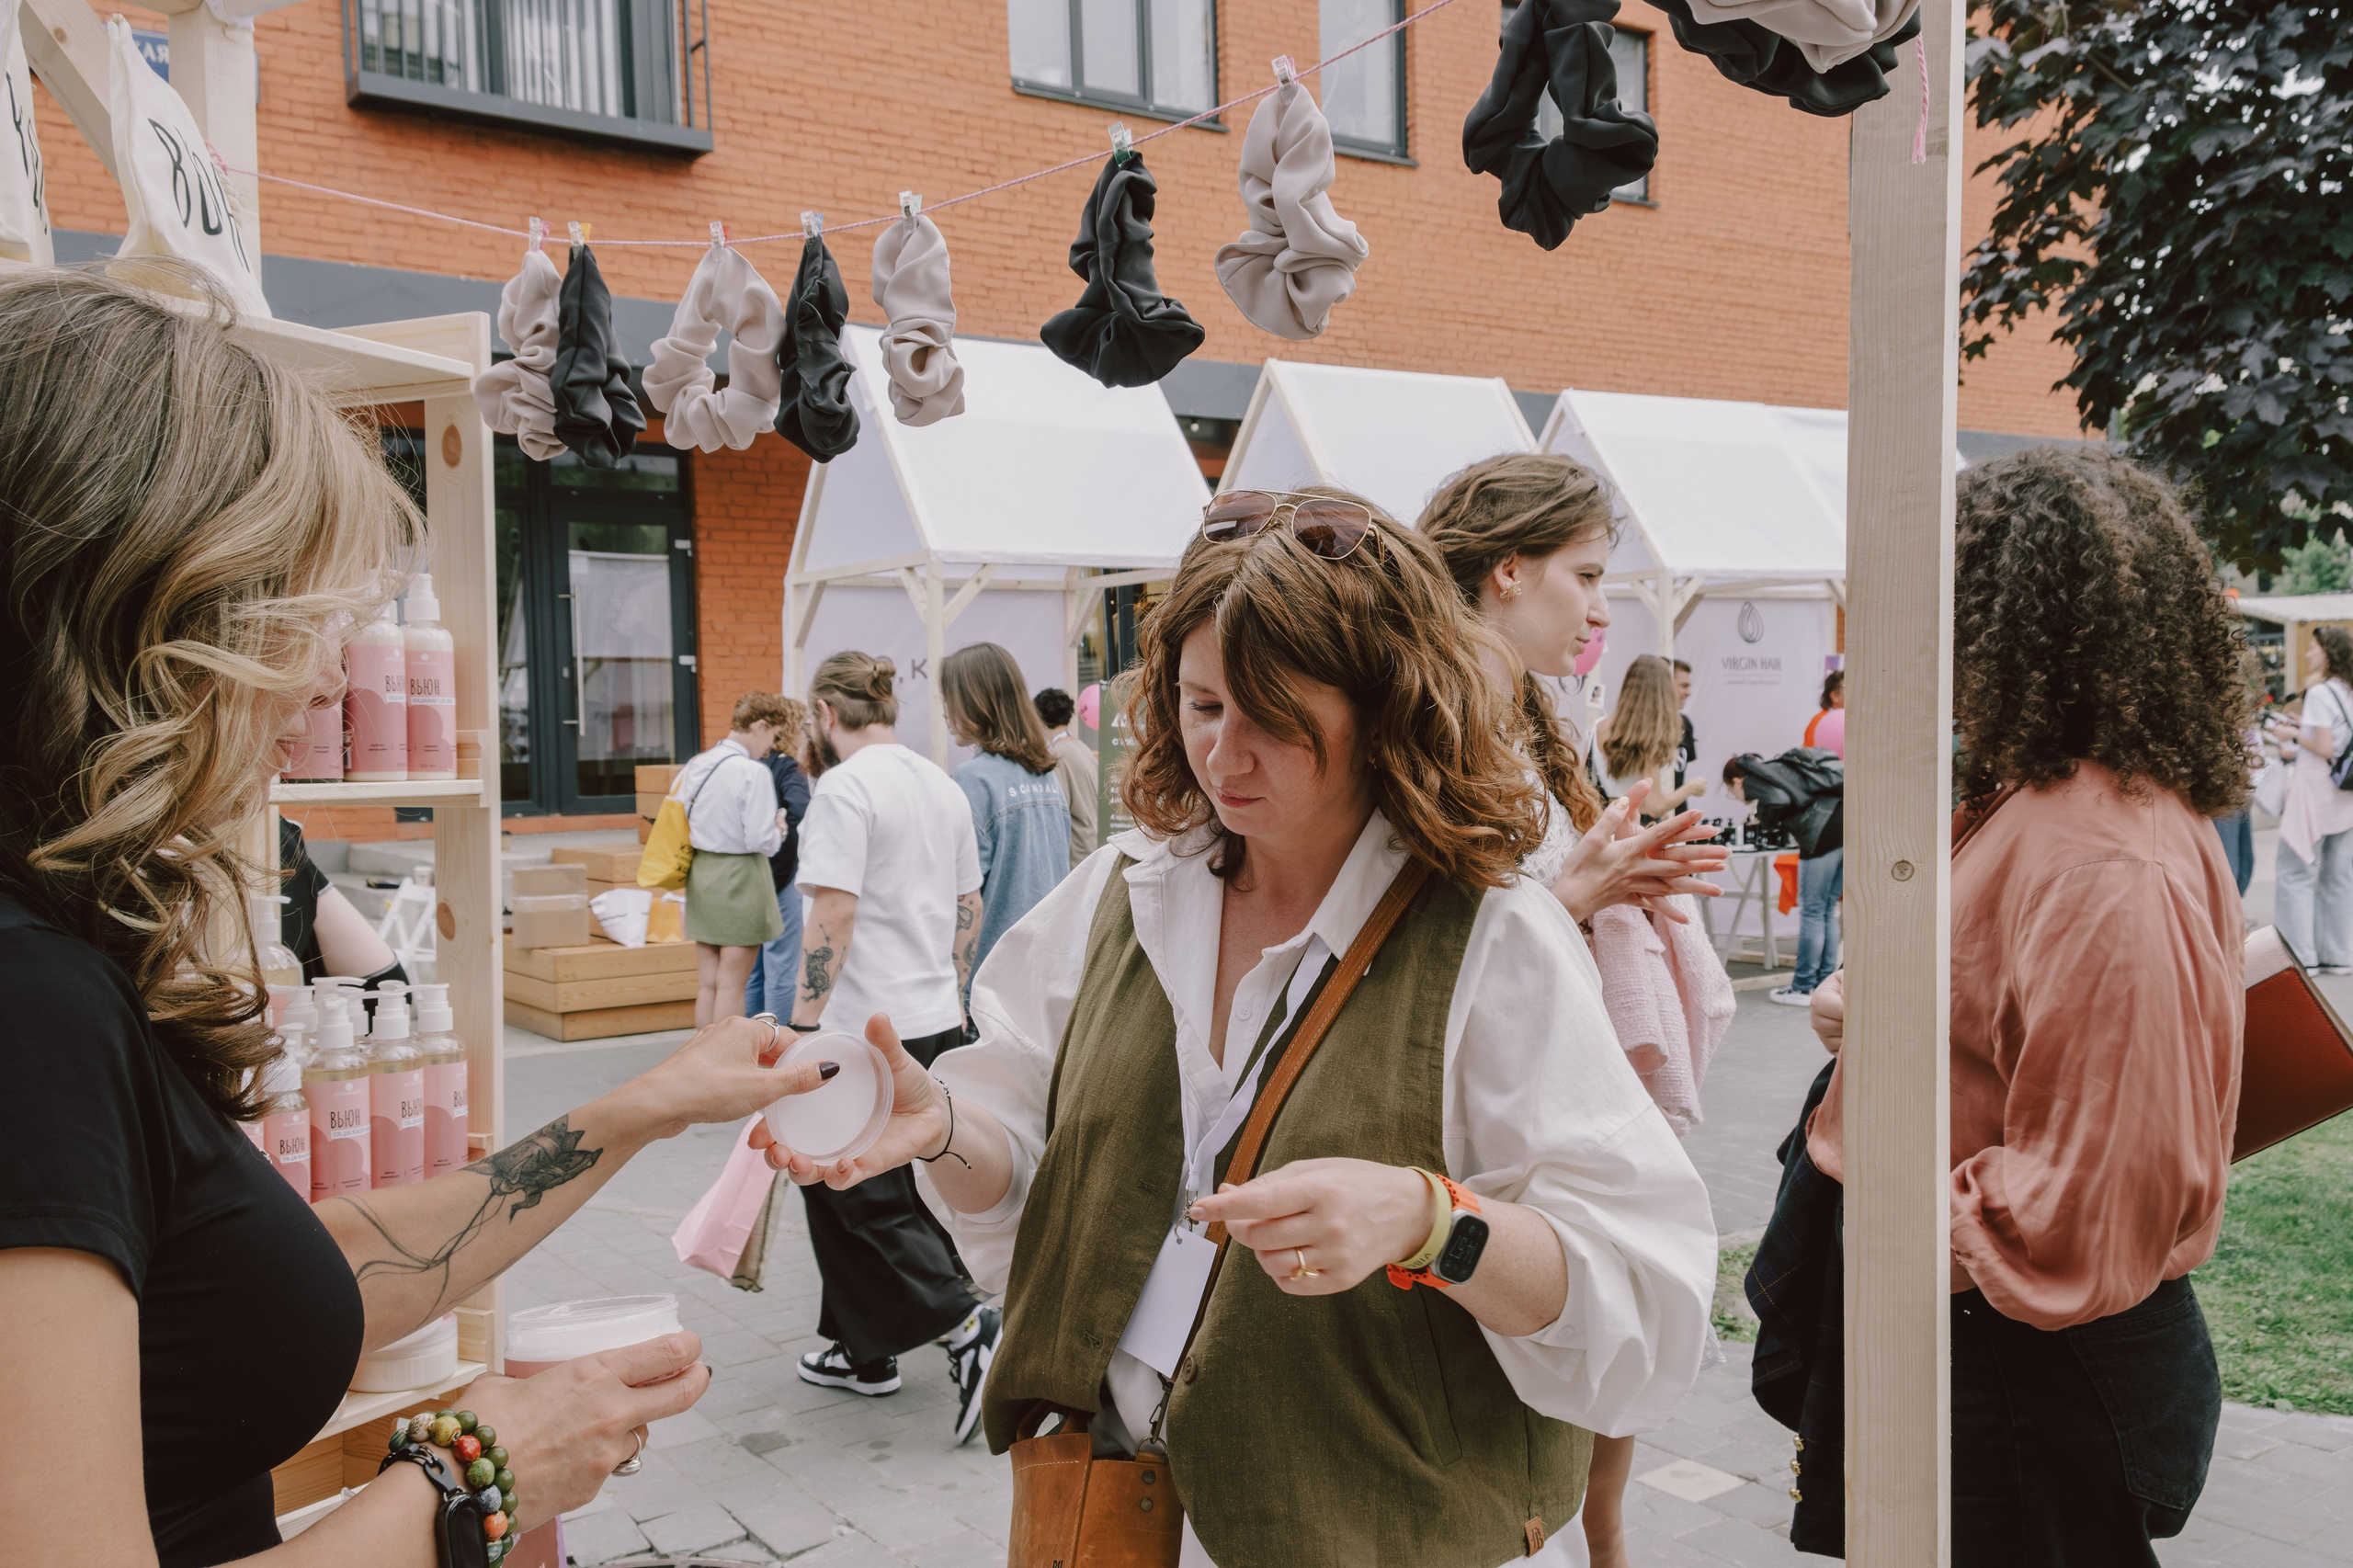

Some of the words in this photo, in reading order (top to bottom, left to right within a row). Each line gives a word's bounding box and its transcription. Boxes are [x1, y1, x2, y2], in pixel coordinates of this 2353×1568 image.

[1722, 656, 1757, 670] VIRGIN
[1760, 656, 1782, 671] HAIR
[410, 678, 440, 696] ВЬЮН
[330, 1108, 360, 1130] ВЬЮН
[280, 1137, 305, 1154] ВЬЮН
